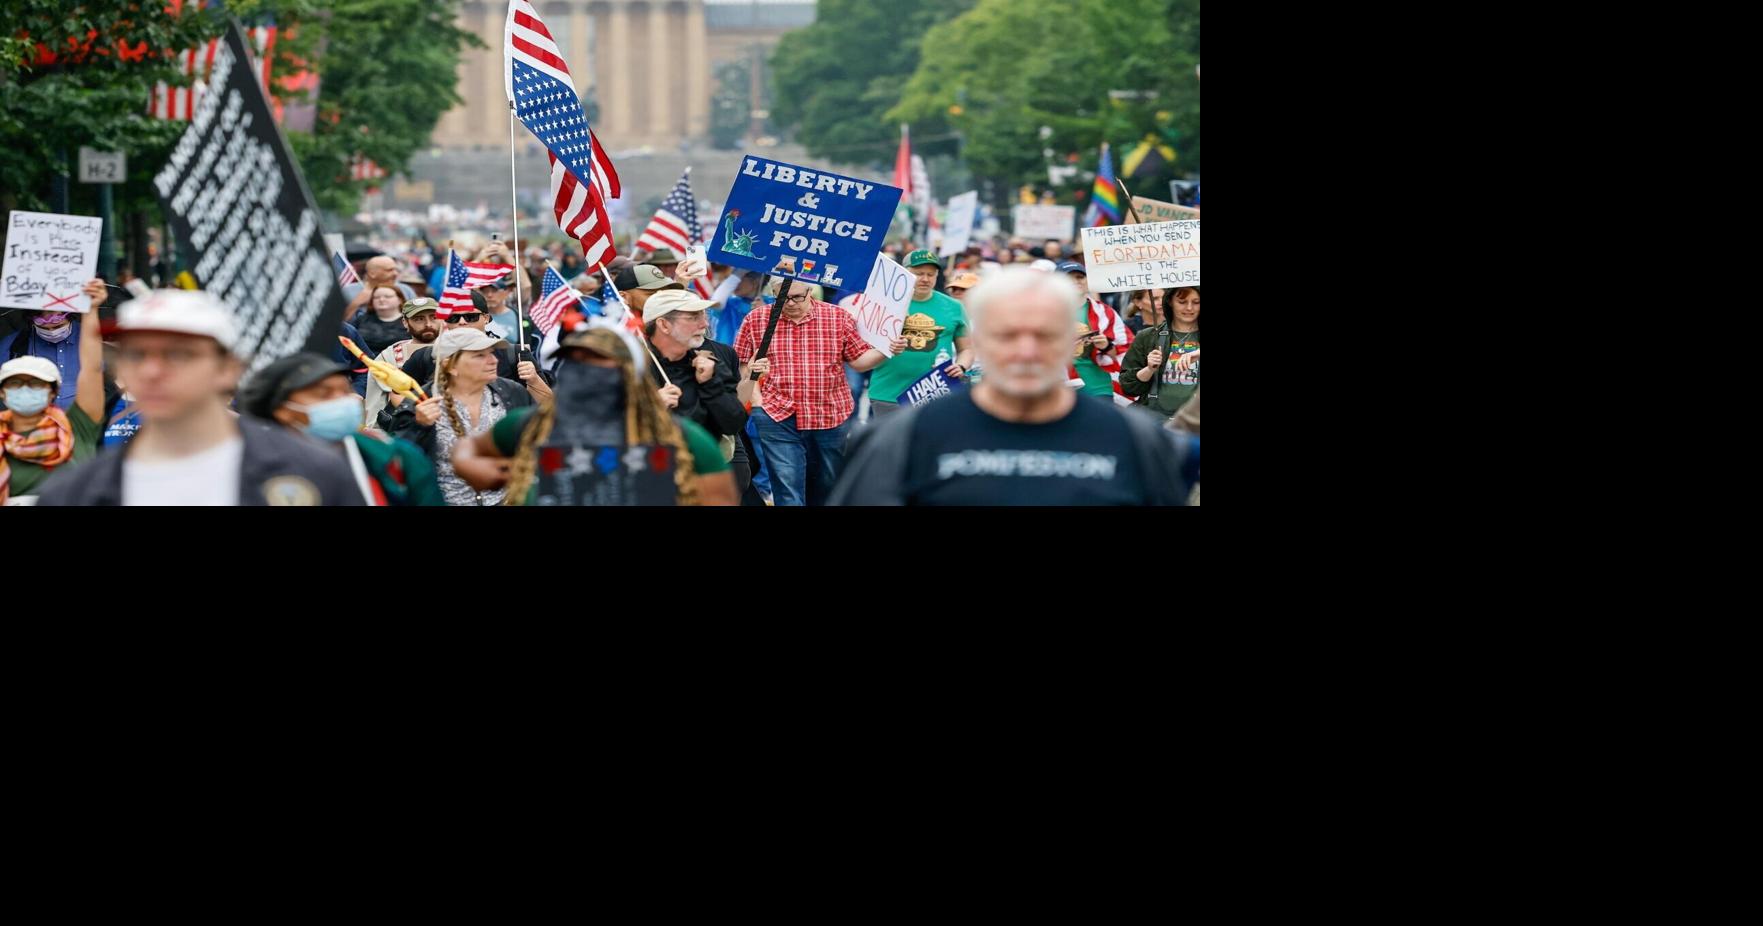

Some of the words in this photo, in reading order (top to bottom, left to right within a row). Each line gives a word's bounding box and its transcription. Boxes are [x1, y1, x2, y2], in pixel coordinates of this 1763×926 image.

[742, 159, 874, 200] LIBERTY
[797, 192, 821, 209] &
[1137, 204, 1152, 214] JD
[13, 214, 98, 243] Everybody
[760, 203, 873, 241] JUSTICE
[1087, 227, 1114, 237] THIS
[1118, 226, 1129, 235] IS
[1133, 224, 1158, 235] WHAT
[769, 231, 830, 256] FOR
[1104, 237, 1137, 246] WHEN
[1140, 233, 1160, 243] YOU
[1164, 231, 1192, 242] SEND
[10, 243, 84, 265] Instead
[1092, 243, 1200, 263] FLORIDAMA
[771, 254, 843, 287] ALL
[1138, 262, 1153, 271] TO
[1159, 260, 1179, 270] THE
[6, 275, 48, 298] Bday
[872, 259, 908, 302] NO
[1108, 273, 1154, 288] WHITE
[1160, 270, 1200, 284] HOUSE
[857, 295, 902, 341] KINGS
[906, 390, 915, 405] I
[911, 369, 946, 401] HAVE
